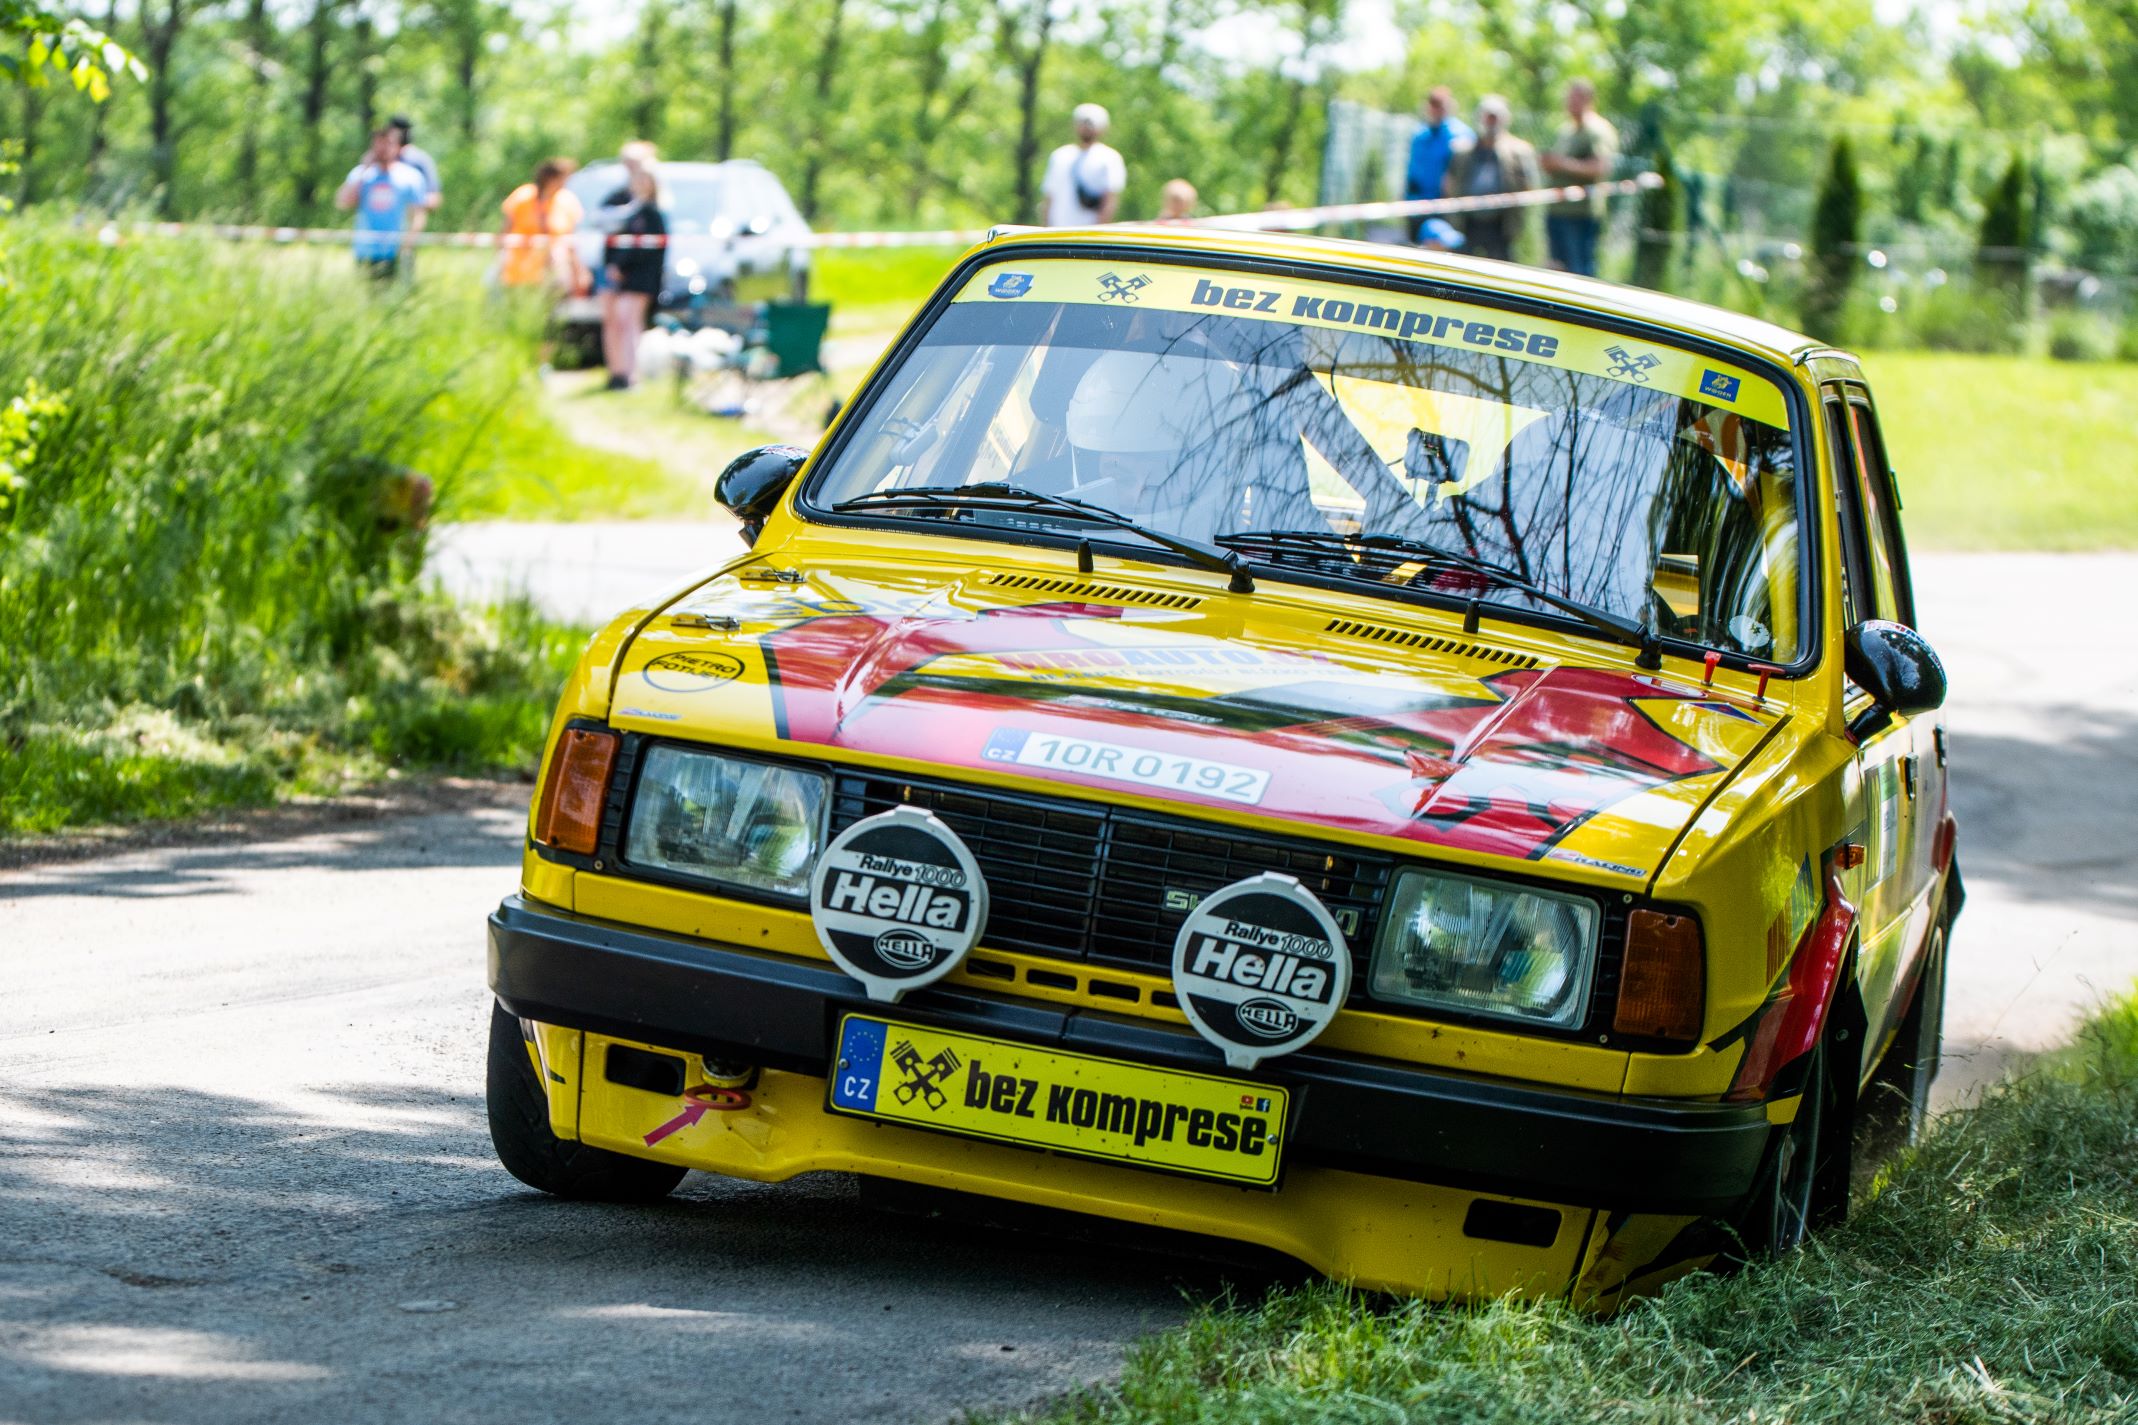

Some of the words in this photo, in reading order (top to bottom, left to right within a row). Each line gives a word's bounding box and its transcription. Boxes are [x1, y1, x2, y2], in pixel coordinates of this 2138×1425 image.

[1190, 279, 1282, 313] bez
[1291, 294, 1559, 358] komprese
[987, 748, 1017, 760] CZ
[1040, 740, 1124, 773] 10R
[1131, 754, 1258, 798] 0192
[860, 854, 913, 877] Rallye
[914, 863, 968, 890] 1000
[829, 872, 962, 929] Hella
[879, 936, 934, 961] HELLA
[1224, 920, 1279, 946] Rallye
[1280, 934, 1334, 960] 1000
[1192, 937, 1328, 1000] Hella
[1241, 1006, 1297, 1031] HELLA
[843, 1075, 871, 1100] CZ
[964, 1058, 1040, 1119] bez
[1046, 1083, 1268, 1157] komprese
